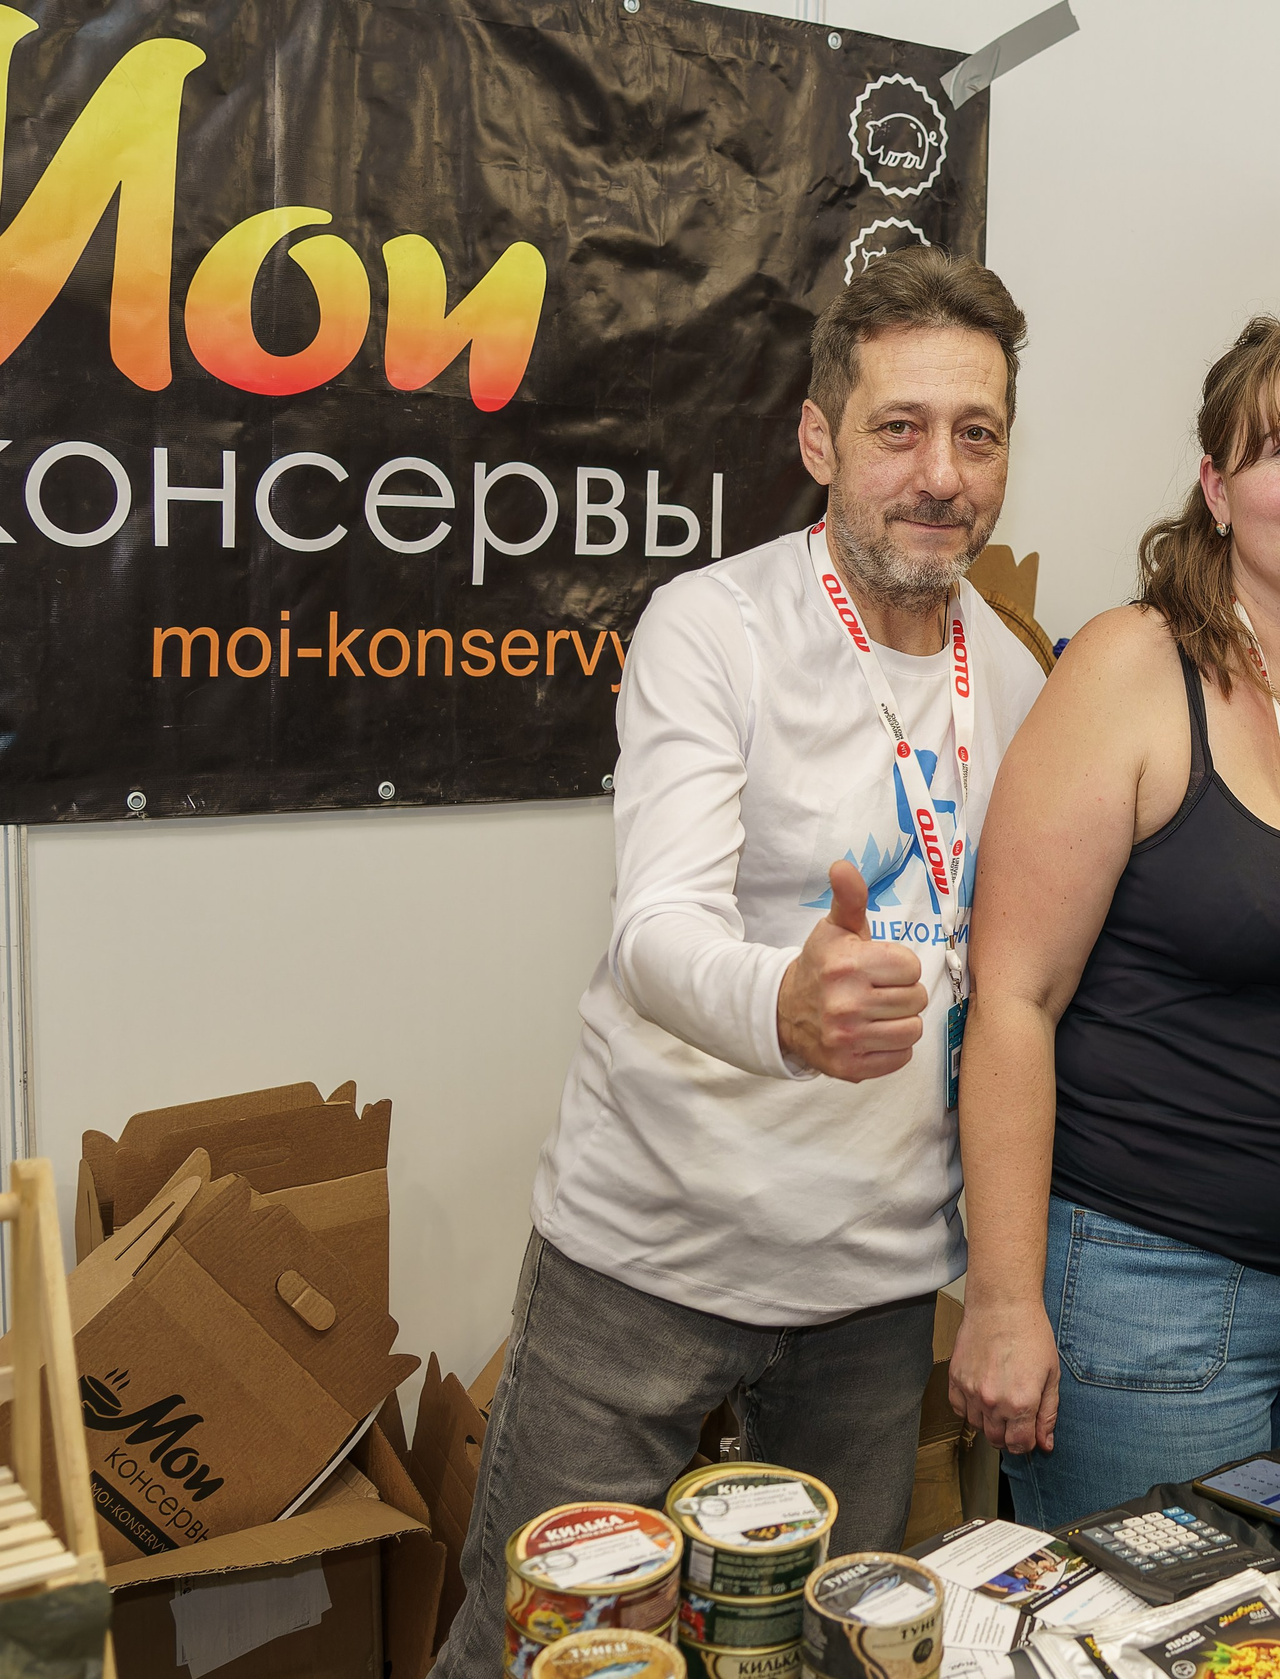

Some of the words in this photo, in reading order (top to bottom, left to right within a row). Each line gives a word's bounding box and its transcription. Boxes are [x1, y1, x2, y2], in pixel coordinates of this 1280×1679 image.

[0, 438, 724, 585] онсервы
[822, 574, 870, 652] MOTO
[952, 619, 970, 698] MOTO
[916, 808, 949, 895] MOTO
[125, 1394, 224, 1502] Мои
[545, 1514, 625, 1542] КИЛЬКА
[823, 1564, 869, 1589] ТУНЕЦ
[901, 1619, 936, 1641] ТУНЕ
[1165, 1629, 1201, 1650] ПЛОВ
[738, 1651, 801, 1675] КИЛЬКА
